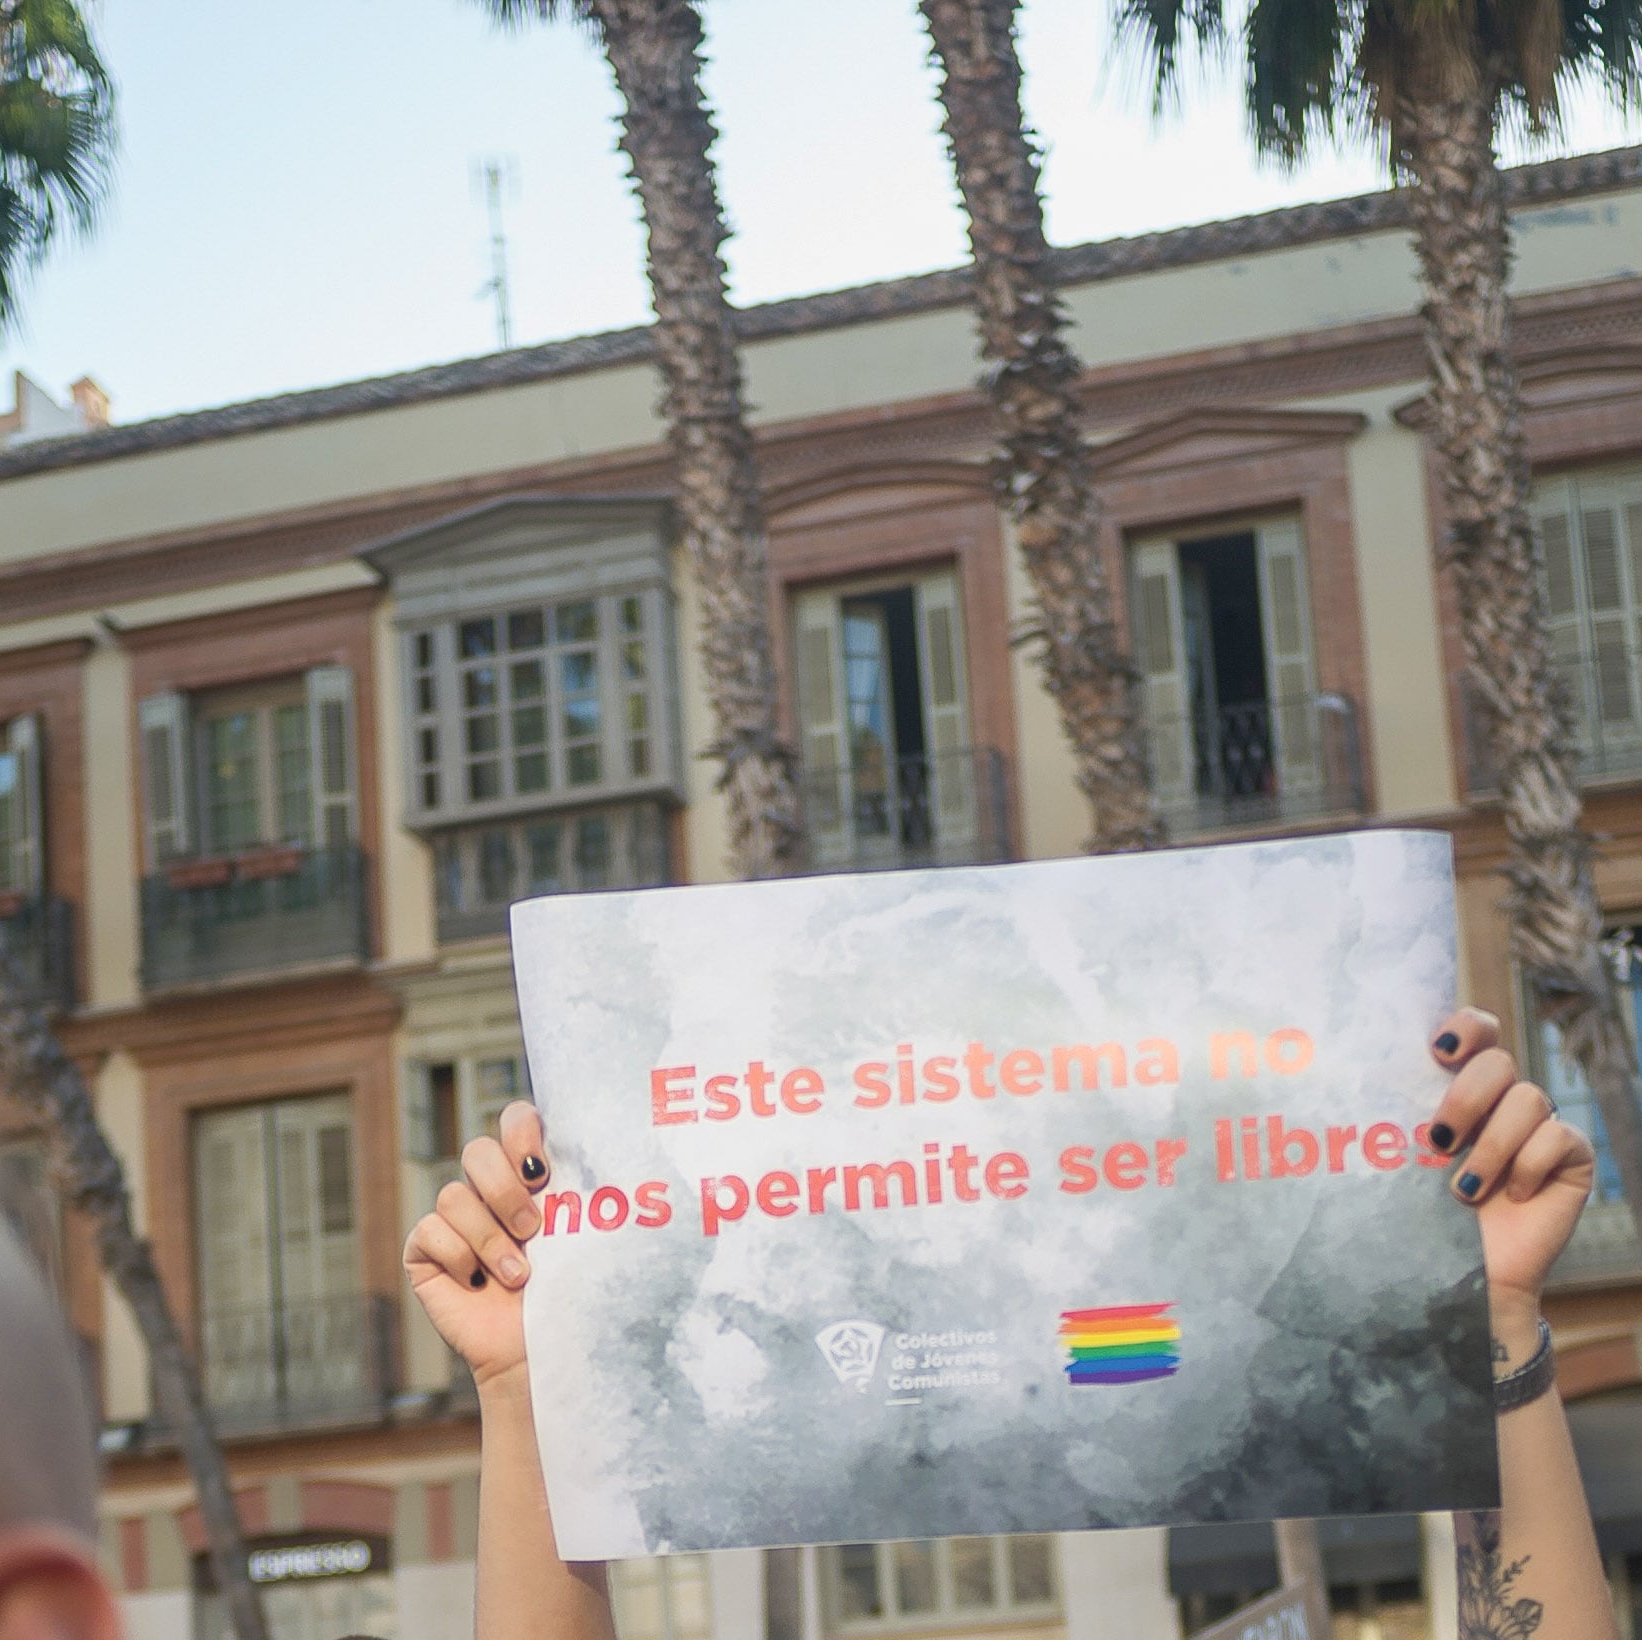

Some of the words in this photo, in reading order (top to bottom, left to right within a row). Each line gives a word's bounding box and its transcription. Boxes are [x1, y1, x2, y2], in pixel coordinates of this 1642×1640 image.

[650, 1061, 824, 1127] Este
[854, 1035, 1180, 1108] sistema
[1209, 1026, 1316, 1082] no
[543, 1180, 673, 1237] nos
[700, 1141, 1030, 1237] permite
[1059, 1138, 1187, 1194] ser
[895, 1329, 998, 1350] Colectivos
[890, 1354, 918, 1371] de
[920, 1351, 999, 1370] Jóvenes
[887, 1369, 1001, 1391] Comunistas
